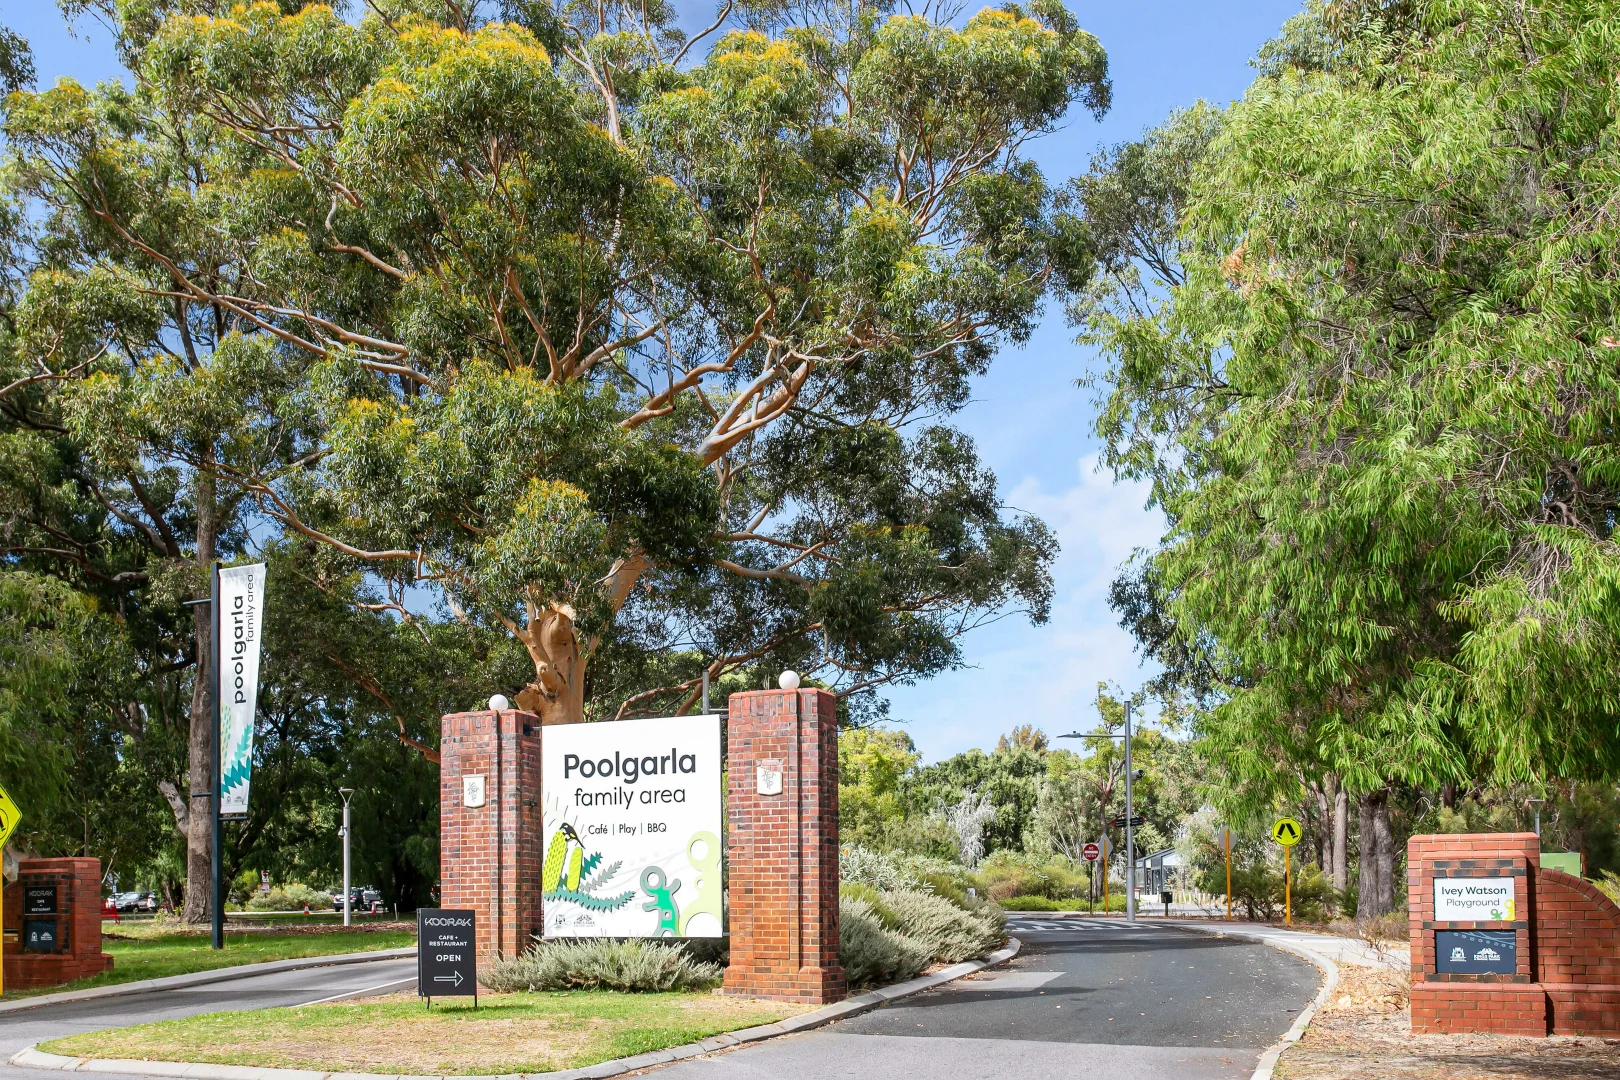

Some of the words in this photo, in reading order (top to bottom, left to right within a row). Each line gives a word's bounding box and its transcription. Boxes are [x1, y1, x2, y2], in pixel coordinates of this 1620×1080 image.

[246, 604, 256, 642] family
[231, 595, 246, 704] poolgarla
[564, 748, 697, 784] Poolgarla
[574, 786, 634, 809] family
[639, 789, 686, 804] area
[588, 824, 608, 834] Café
[619, 824, 637, 836] Play
[647, 823, 667, 833] BBQ
[1442, 886, 1463, 897] Ivey
[1465, 886, 1507, 895] Watson
[1446, 898, 1500, 908] Playground
[424, 918, 472, 926] KOORAK
[436, 954, 462, 962] OPEN
